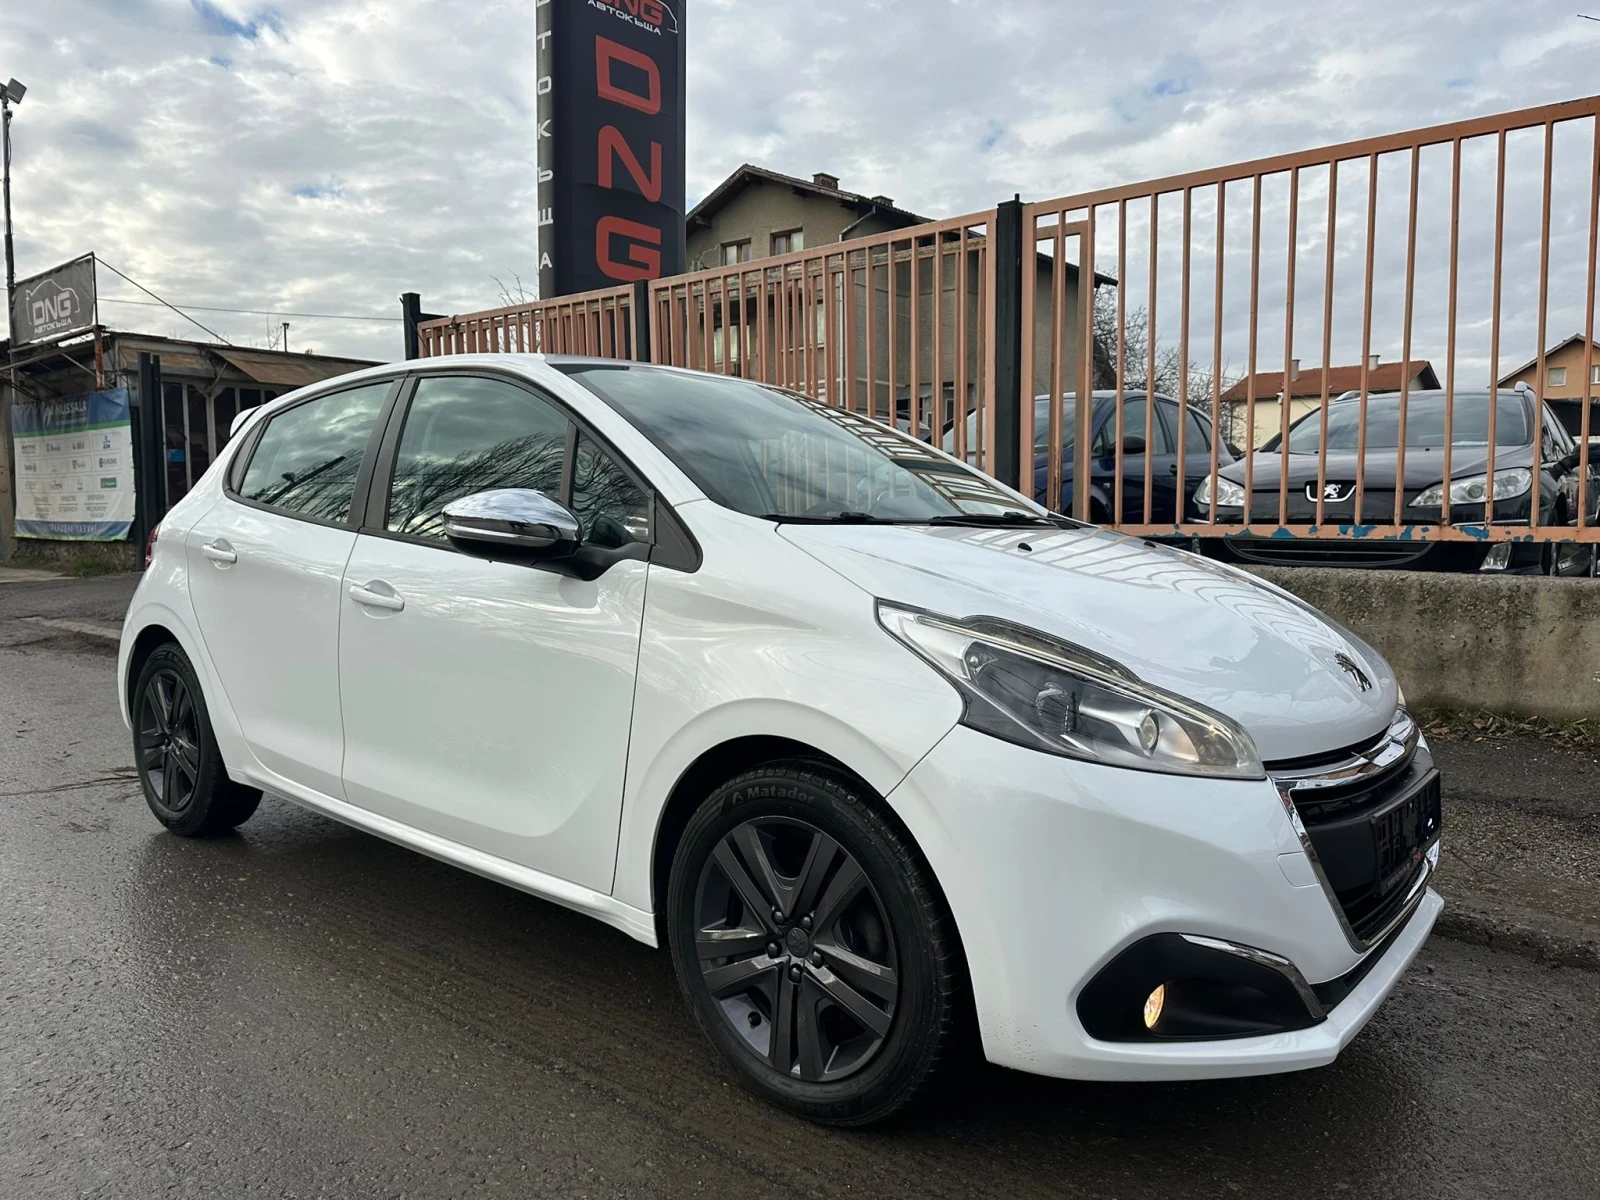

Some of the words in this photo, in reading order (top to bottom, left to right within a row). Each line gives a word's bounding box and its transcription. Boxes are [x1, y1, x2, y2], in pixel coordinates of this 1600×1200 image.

[601, 0, 663, 26] NG
[595, 34, 662, 283] DNG
[32, 291, 71, 326] DNG
[55, 400, 87, 416] MUSSALA
[747, 785, 816, 804] Matador
